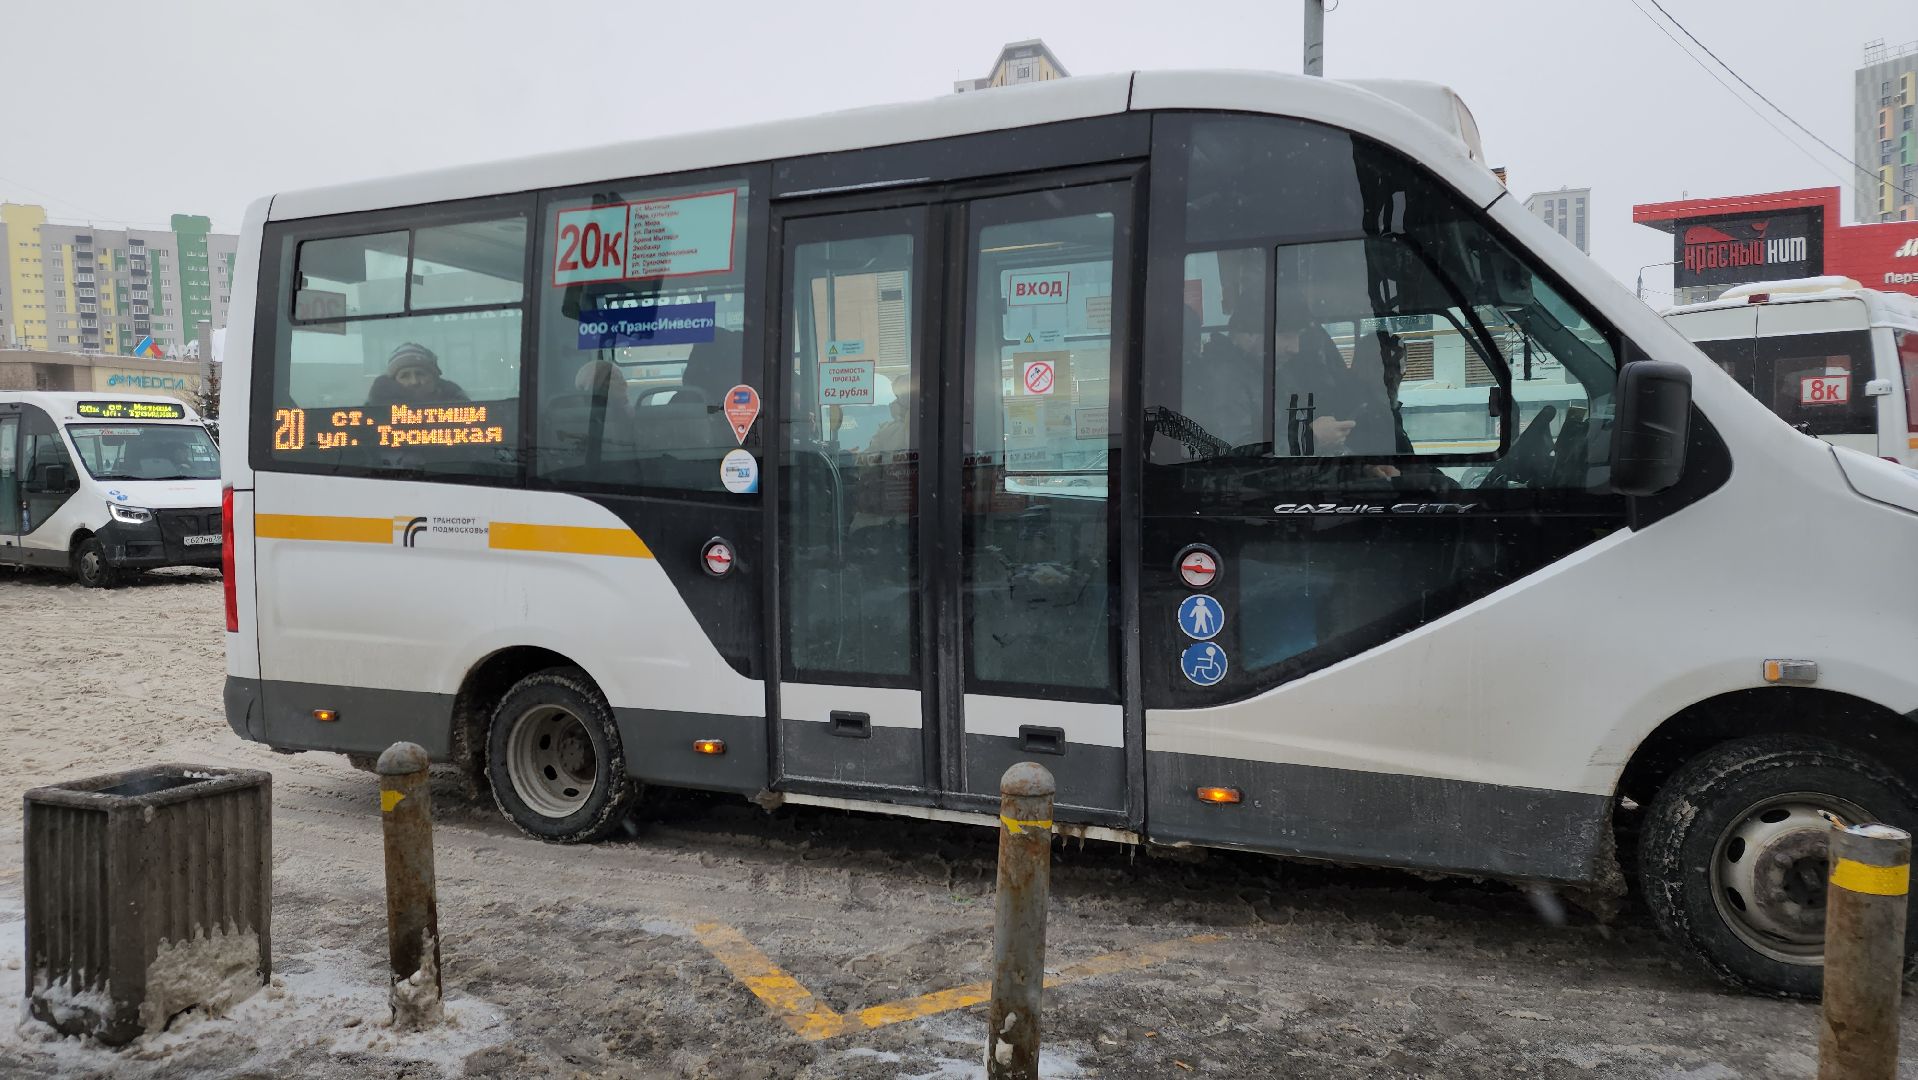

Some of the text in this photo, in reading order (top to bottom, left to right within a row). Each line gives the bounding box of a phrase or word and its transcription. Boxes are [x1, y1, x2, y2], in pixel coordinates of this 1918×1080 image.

[558, 222, 622, 272] 20к
[1016, 280, 1063, 297] ВХОД
[579, 318, 714, 336] ООО «ТрансИнвест»
[824, 386, 868, 399] 62 рубля
[1810, 379, 1840, 401] 8к
[275, 404, 487, 450] 20 ст. Мытищи
[317, 425, 503, 449] ул. Троицкая
[1273, 503, 1385, 514] GAZelle
[432, 517, 476, 525] ТРАНСПОРТ
[432, 526, 489, 534] ПОДМОСКОВЬЯ
